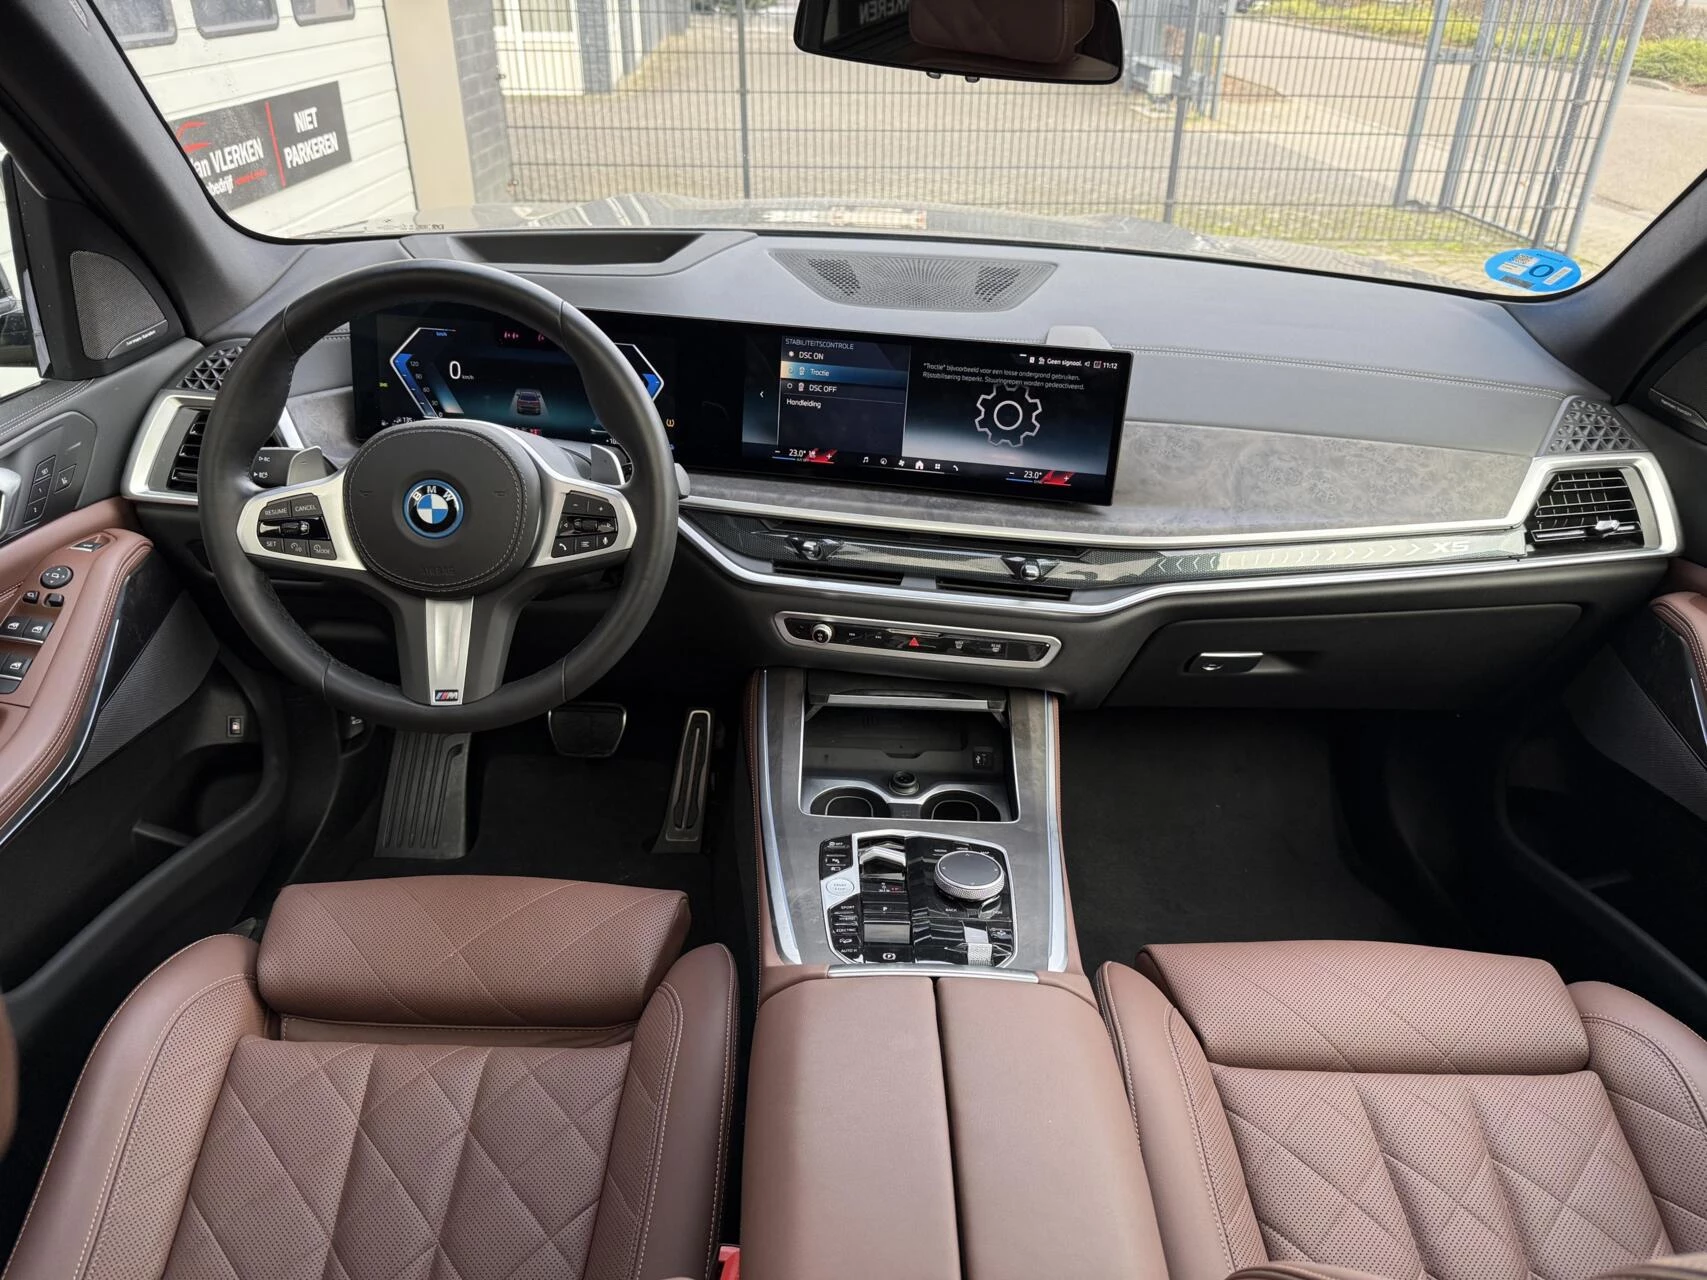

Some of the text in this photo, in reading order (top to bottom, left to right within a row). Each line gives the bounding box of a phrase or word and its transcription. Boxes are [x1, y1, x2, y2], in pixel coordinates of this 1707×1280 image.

[293, 106, 318, 133] NIET
[209, 136, 264, 173] VLERKEN
[283, 131, 339, 168] PARKEREN
[785, 338, 854, 350] STABILITEITSCONTROLE
[799, 351, 812, 359] DSC
[1046, 357, 1061, 365] Geen
[1103, 362, 1118, 370] 11:12
[449, 360, 461, 379] 0
[811, 368, 830, 376] Tractie
[1019, 371, 1051, 379] ondergrond
[809, 384, 837, 393] DSC OFF
[786, 398, 821, 409] Handleiding
[412, 485, 455, 502] BMW
[294, 504, 317, 512] CANCEL
[1428, 541, 1470, 553] X5
